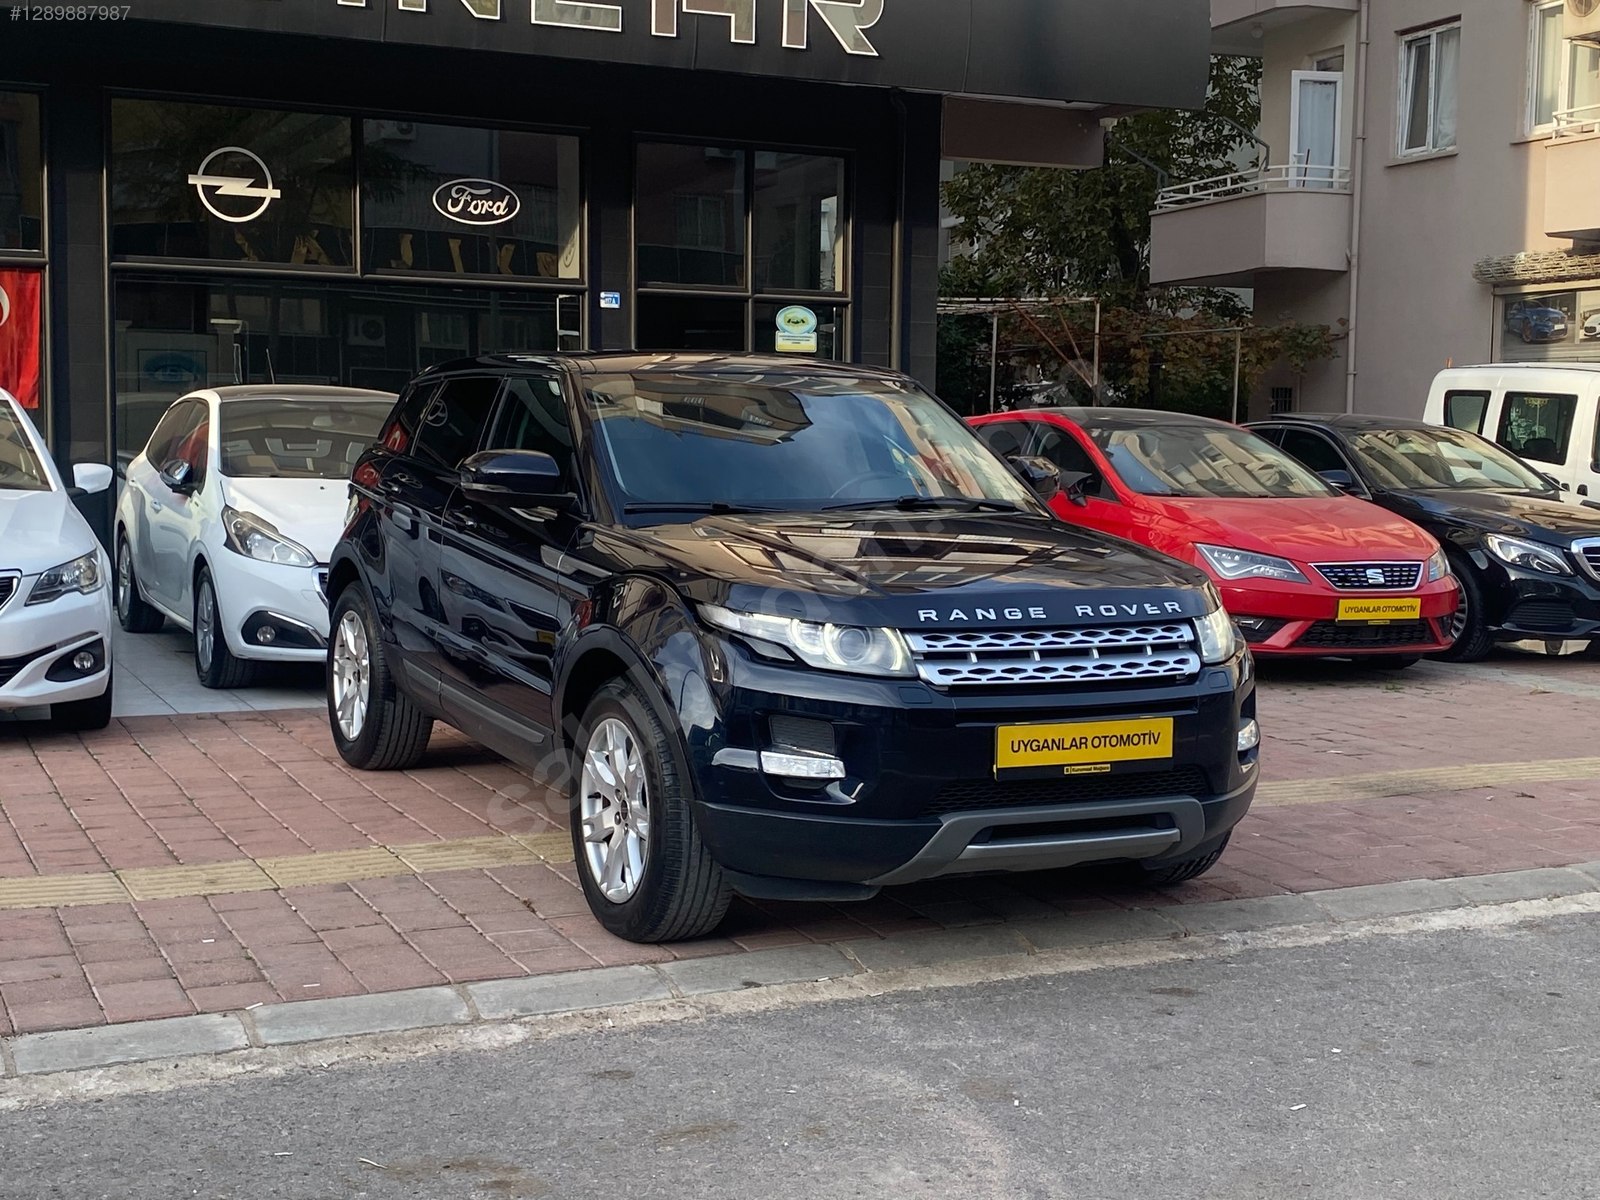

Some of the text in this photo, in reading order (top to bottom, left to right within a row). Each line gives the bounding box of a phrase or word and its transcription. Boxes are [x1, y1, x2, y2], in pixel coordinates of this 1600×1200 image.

[447, 185, 510, 216] Ford
[918, 601, 1183, 622] RANGE ROVER
[1344, 605, 1381, 613] UYGANLAR
[1011, 730, 1161, 753] UYGANLAR OTOMOTİV
